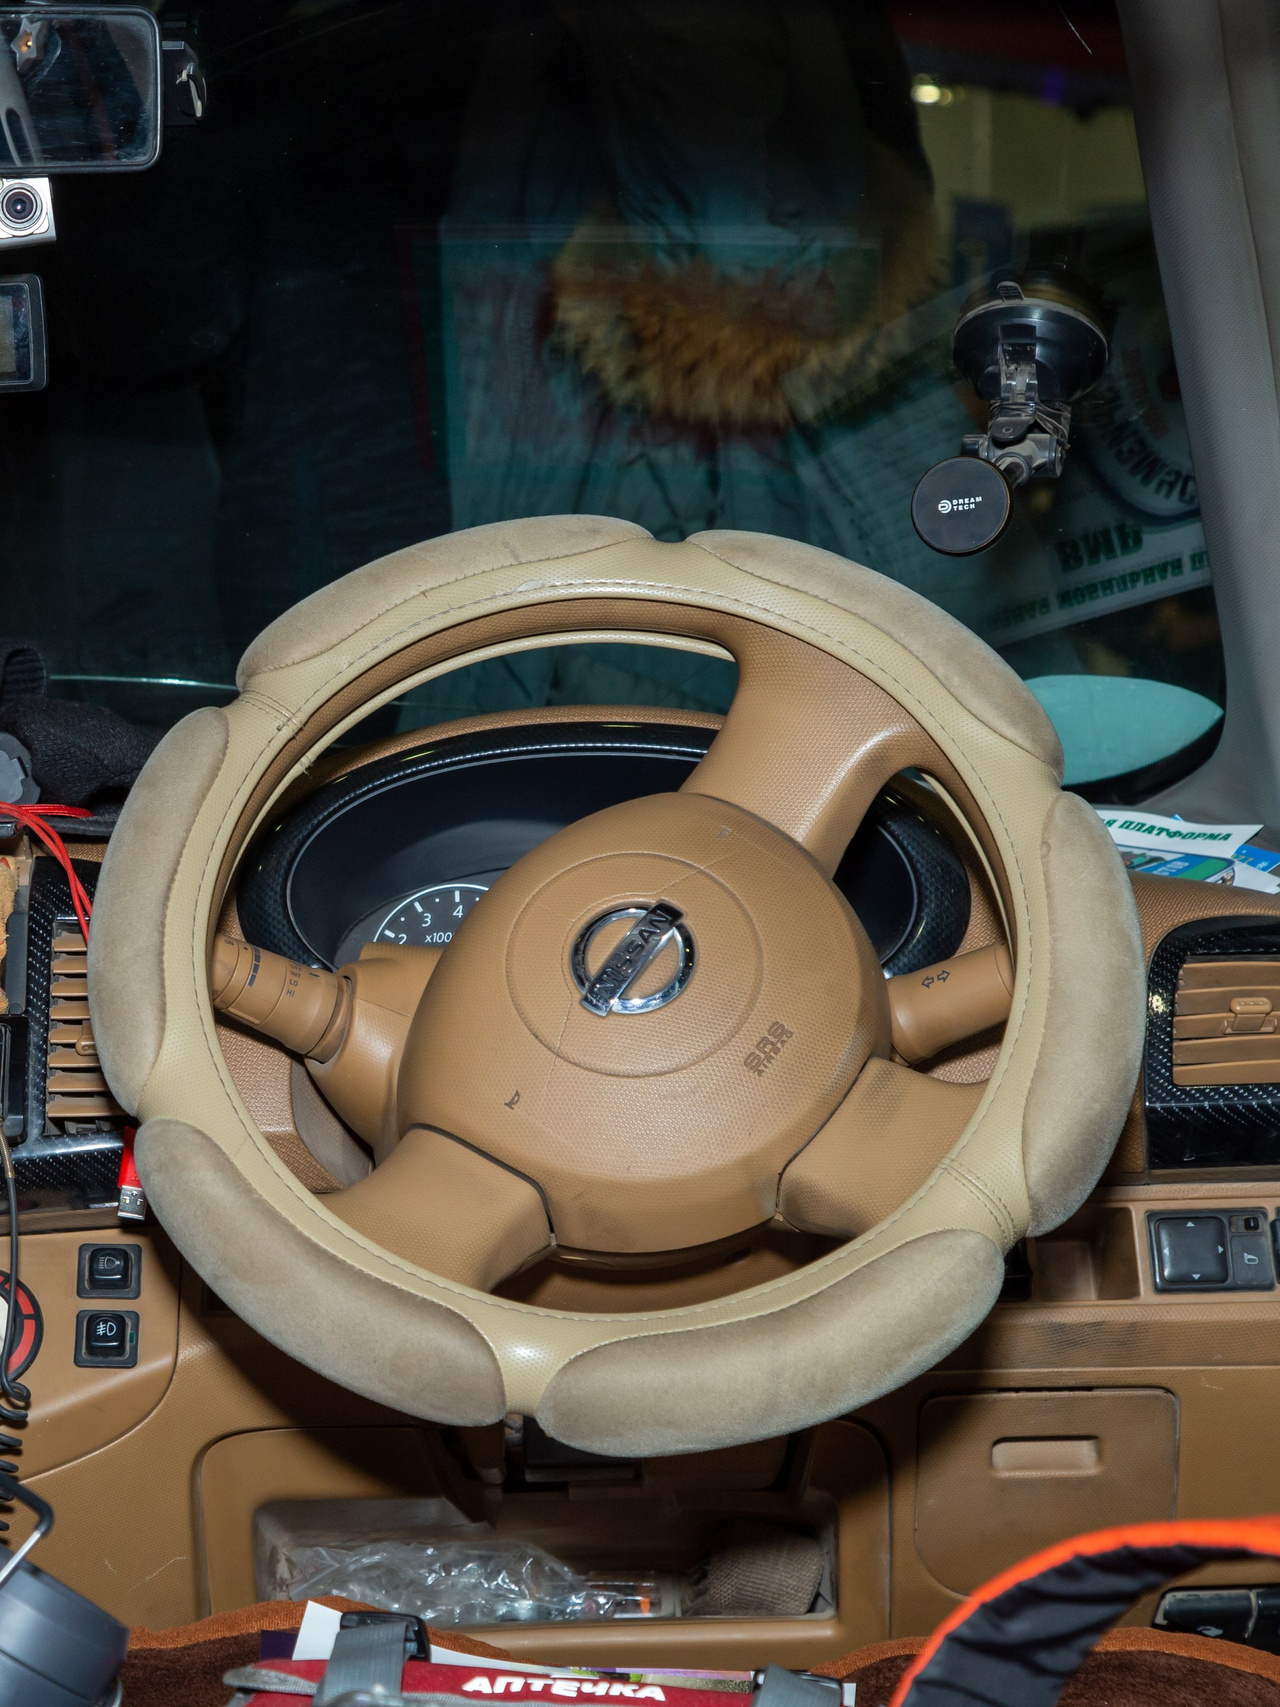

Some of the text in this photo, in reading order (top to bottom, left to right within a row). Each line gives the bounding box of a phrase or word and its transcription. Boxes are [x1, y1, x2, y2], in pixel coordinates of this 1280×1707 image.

[952, 496, 982, 505] DREAM
[953, 503, 975, 511] TECH
[1118, 820, 1233, 841] ПЛАТФОРМА
[452, 904, 464, 918] 4
[421, 913, 432, 927] 3
[424, 931, 455, 943] x100
[290, 971, 301, 979] INT
[289, 979, 299, 987] LO
[286, 988, 296, 997] HI
[743, 1021, 786, 1071] SRS
[461, 1676, 666, 1702] АПТЕЧКА
